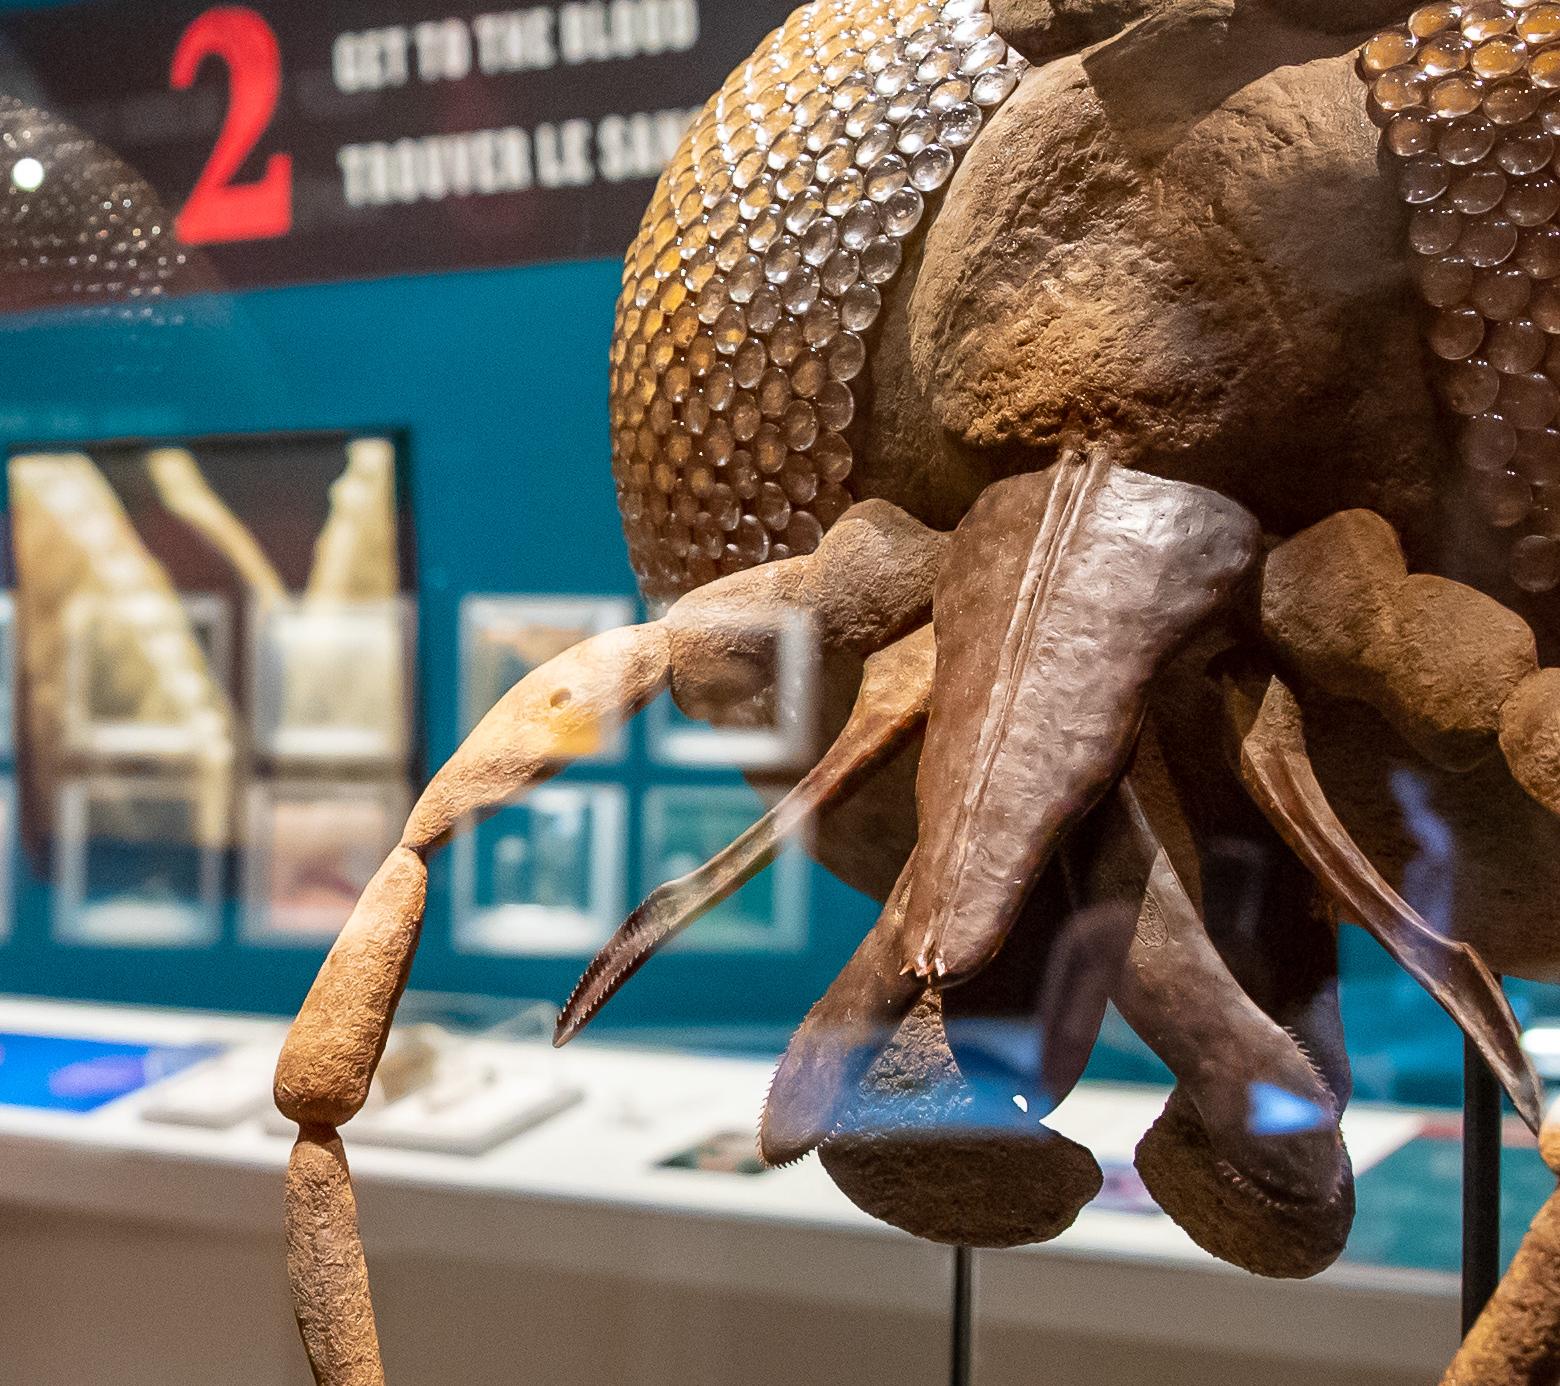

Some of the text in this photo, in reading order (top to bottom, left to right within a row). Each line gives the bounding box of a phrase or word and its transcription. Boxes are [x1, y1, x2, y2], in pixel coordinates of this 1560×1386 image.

[331, 24, 409, 94] GET
[414, 16, 472, 83] TO
[474, 6, 555, 75] THE
[168, 4, 294, 246] 2
[337, 105, 704, 209] TROUVER LE SAN
